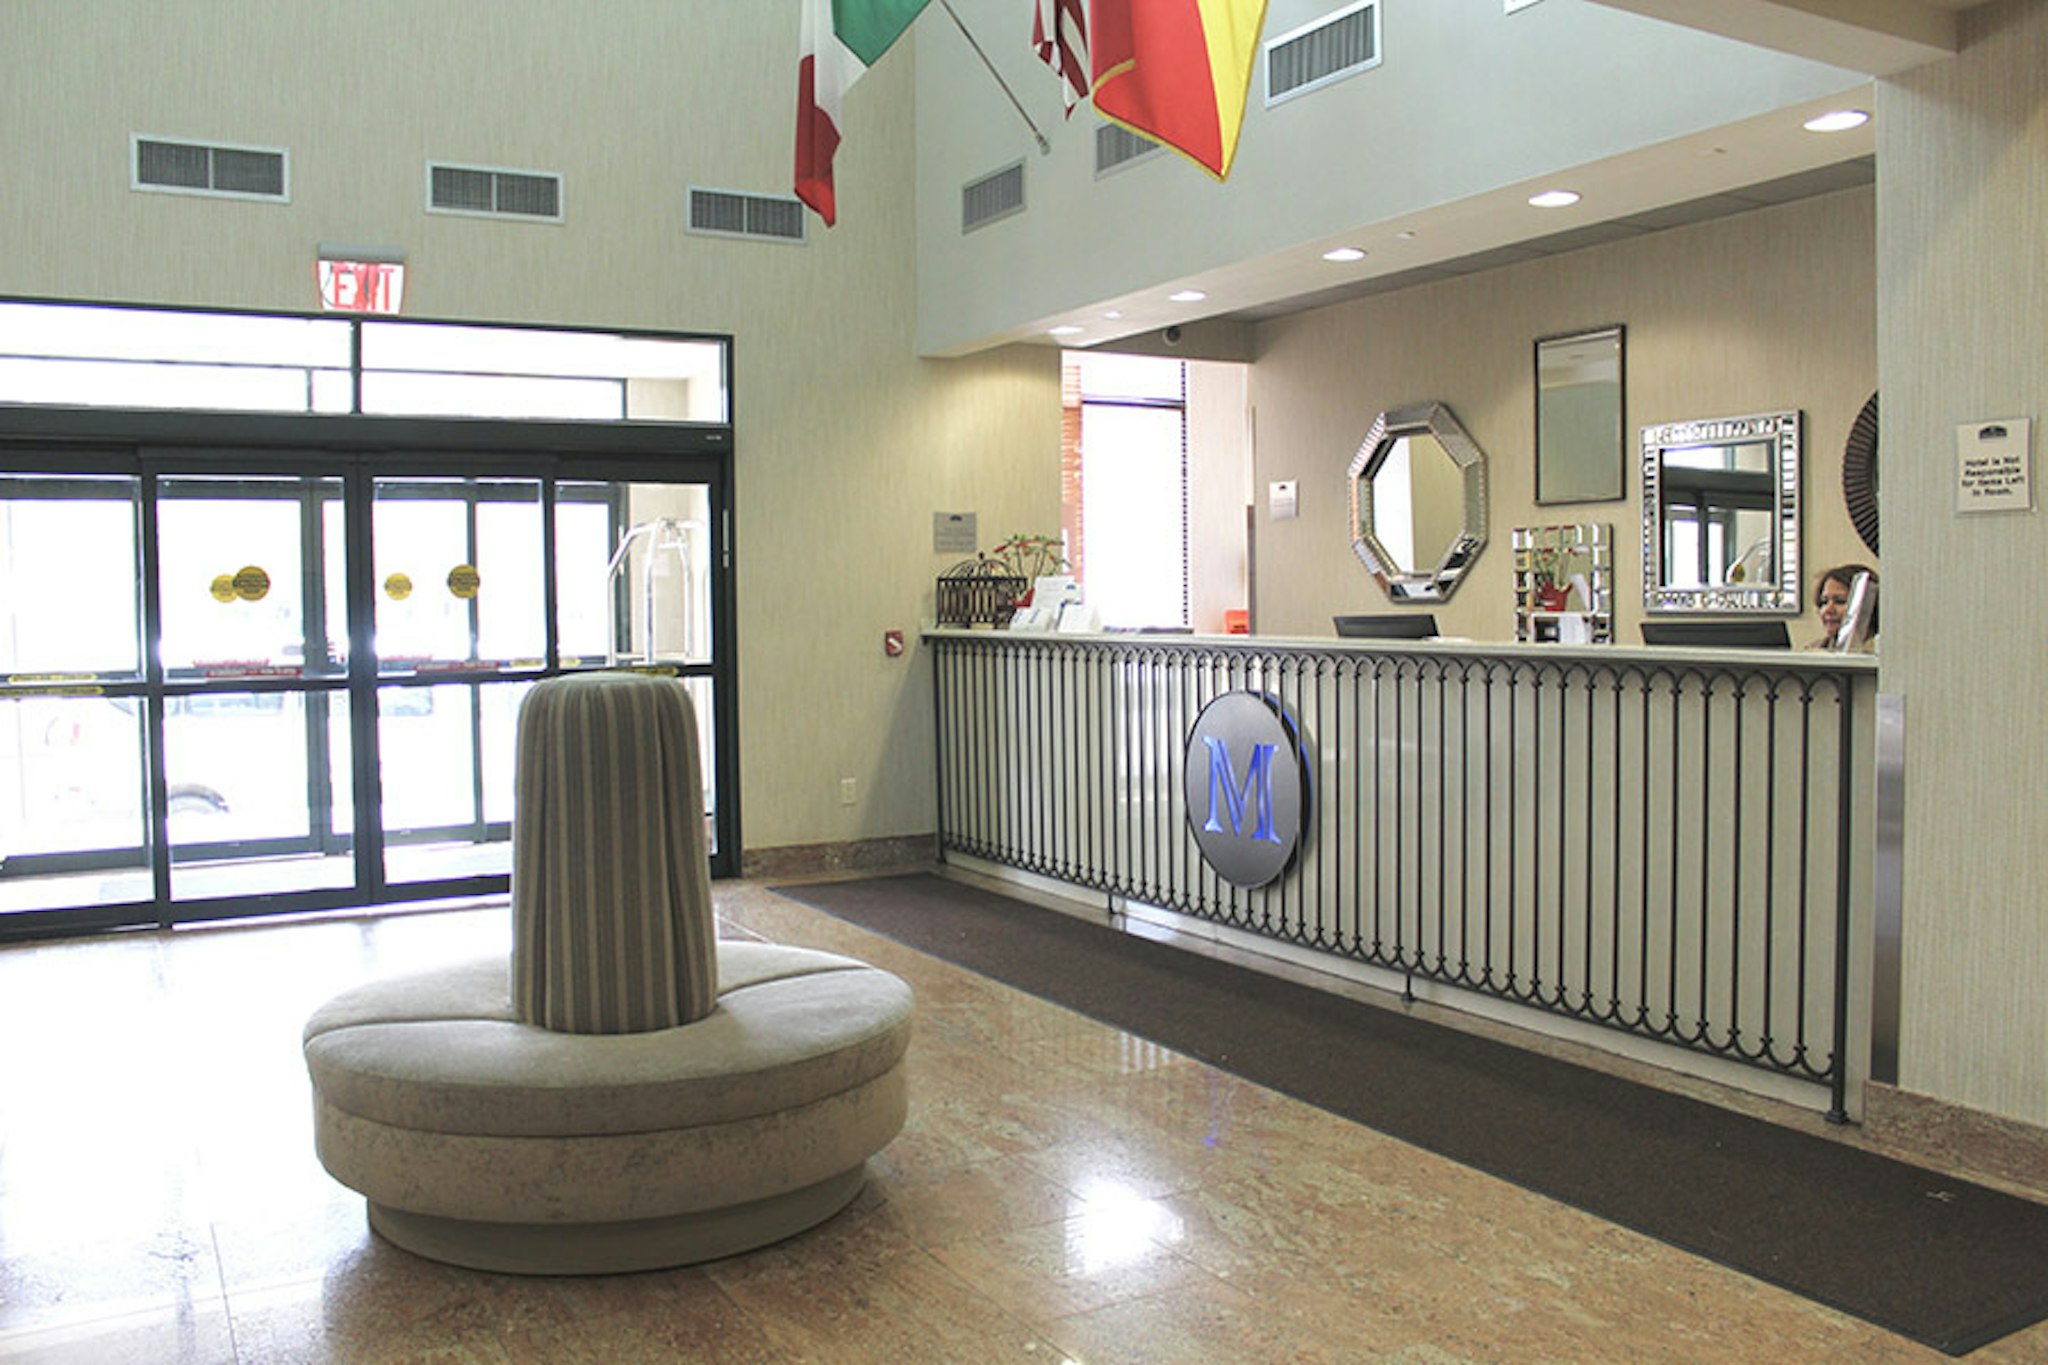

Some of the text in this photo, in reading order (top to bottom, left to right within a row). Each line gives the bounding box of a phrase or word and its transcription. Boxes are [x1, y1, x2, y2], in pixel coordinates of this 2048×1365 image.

[332, 262, 394, 310] EXIT
[1965, 458, 1989, 467] Hotel
[2003, 456, 2019, 464] Not
[1965, 467, 2020, 477] Responsible
[2005, 476, 2025, 485] Left
[1201, 735, 1282, 844] M
